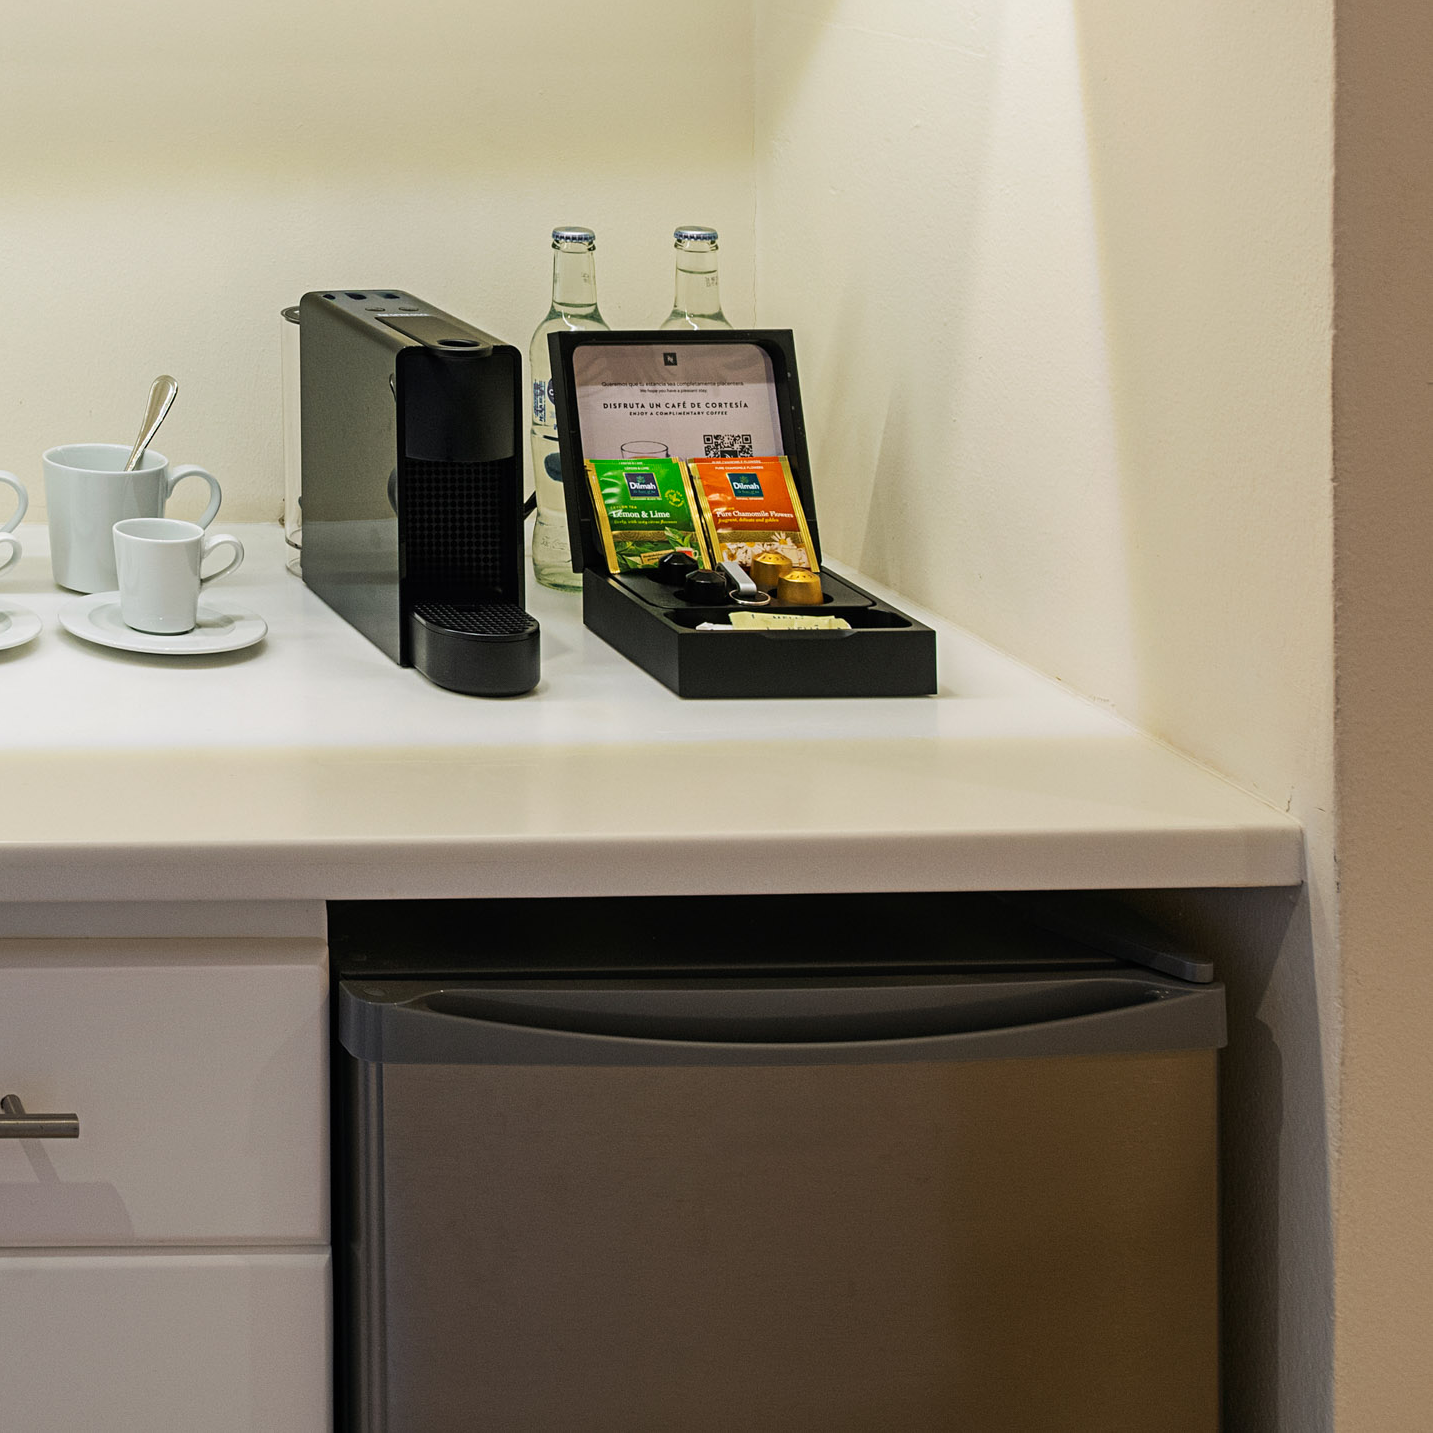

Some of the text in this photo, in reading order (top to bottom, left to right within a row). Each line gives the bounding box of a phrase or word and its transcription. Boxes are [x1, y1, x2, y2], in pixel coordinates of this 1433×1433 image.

[665, 400, 686, 408] CAFÉ
[705, 400, 748, 408] CORTESÍA
[629, 481, 656, 489] Dilmah
[641, 510, 648, 518] &
[649, 510, 670, 518] Lime
